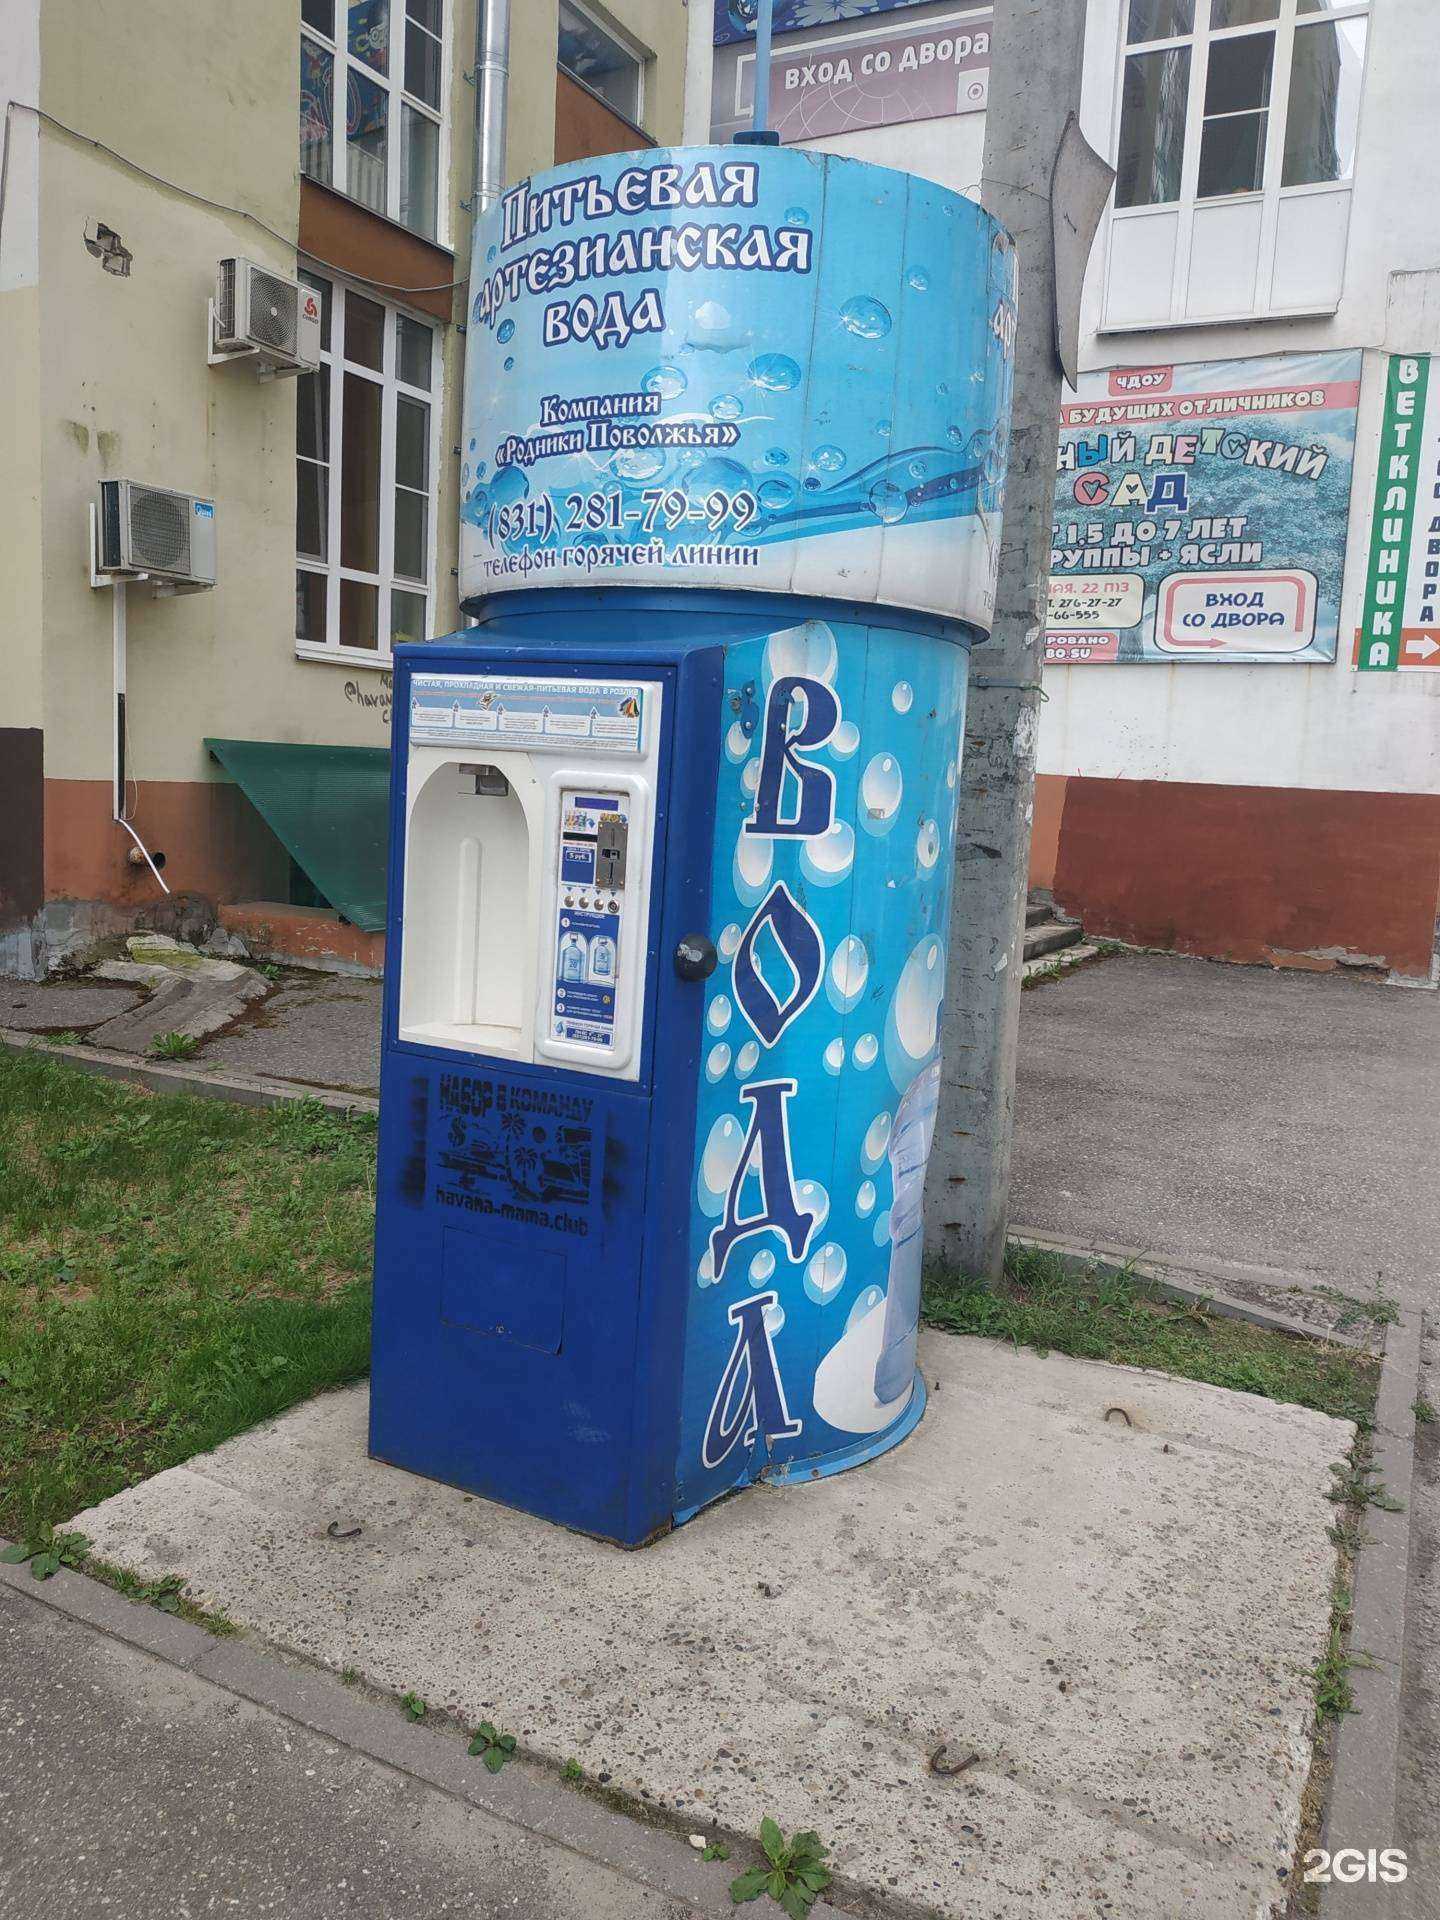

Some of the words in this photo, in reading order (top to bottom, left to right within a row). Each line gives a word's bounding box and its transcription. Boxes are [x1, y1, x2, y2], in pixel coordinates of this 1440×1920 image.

[1116, 373, 1167, 389] ЧДОУ
[540, 392, 661, 426] Компания
[1069, 401, 1176, 424] БУДУЩИХ
[1178, 389, 1326, 415] ОТЛИЧНИКОВ
[495, 430, 584, 466] «Родники
[586, 420, 741, 450] Поволжья»
[1056, 431, 1137, 471] НЫЙ
[1143, 427, 1329, 480] ДЕТСКИЙ
[1073, 470, 1189, 514] САД
[488, 493, 554, 549] (831)
[566, 489, 757, 533] 281-79-99
[1369, 358, 1419, 666] ВЕТКЛИНИКА
[1110, 520, 1157, 547] ДО
[1164, 520, 1183, 542] 7
[1187, 516, 1249, 541] ЛЕТ
[562, 538, 663, 575] горячей
[672, 546, 760, 569] линии
[1050, 545, 1151, 568] РУППЫ
[1180, 543, 1263, 566] ЯСЛИ
[1049, 582, 1077, 594] АЯ.
[1081, 583, 1099, 594] 22
[1059, 597, 1123, 608] 276-27-27
[1205, 592, 1264, 608] ВХОД
[1047, 610, 1100, 620] -66-555
[1182, 613, 1206, 628] СО
[1210, 611, 1285, 629] ДВОРА
[1046, 635, 1110, 646] РОВАНО
[1046, 647, 1092, 659] BO.SU
[702, 676, 841, 1468] ВОДА
